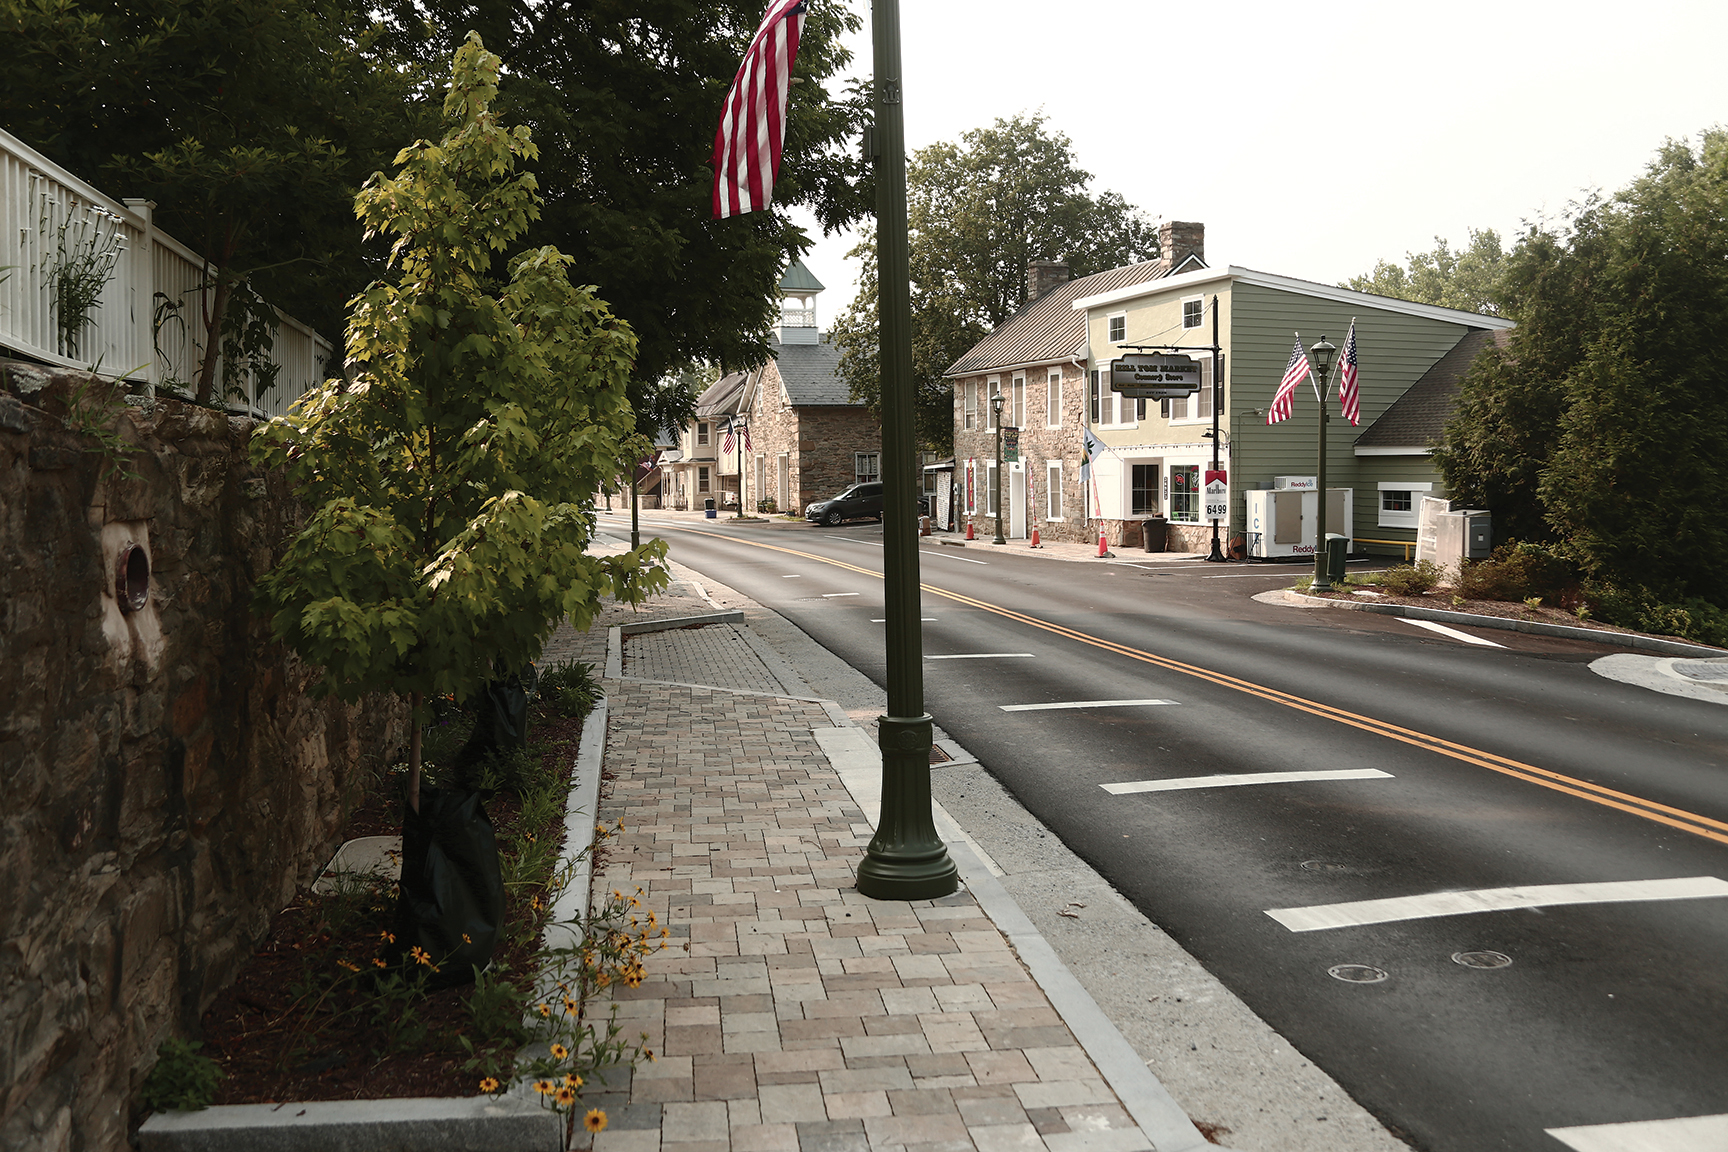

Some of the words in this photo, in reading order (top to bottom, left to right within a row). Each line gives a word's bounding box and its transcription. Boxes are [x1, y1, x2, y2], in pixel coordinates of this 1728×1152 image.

[1115, 364, 1136, 372] HILL
[1160, 365, 1198, 373] MARKET
[1134, 373, 1163, 382] Country
[1165, 373, 1183, 381] Store
